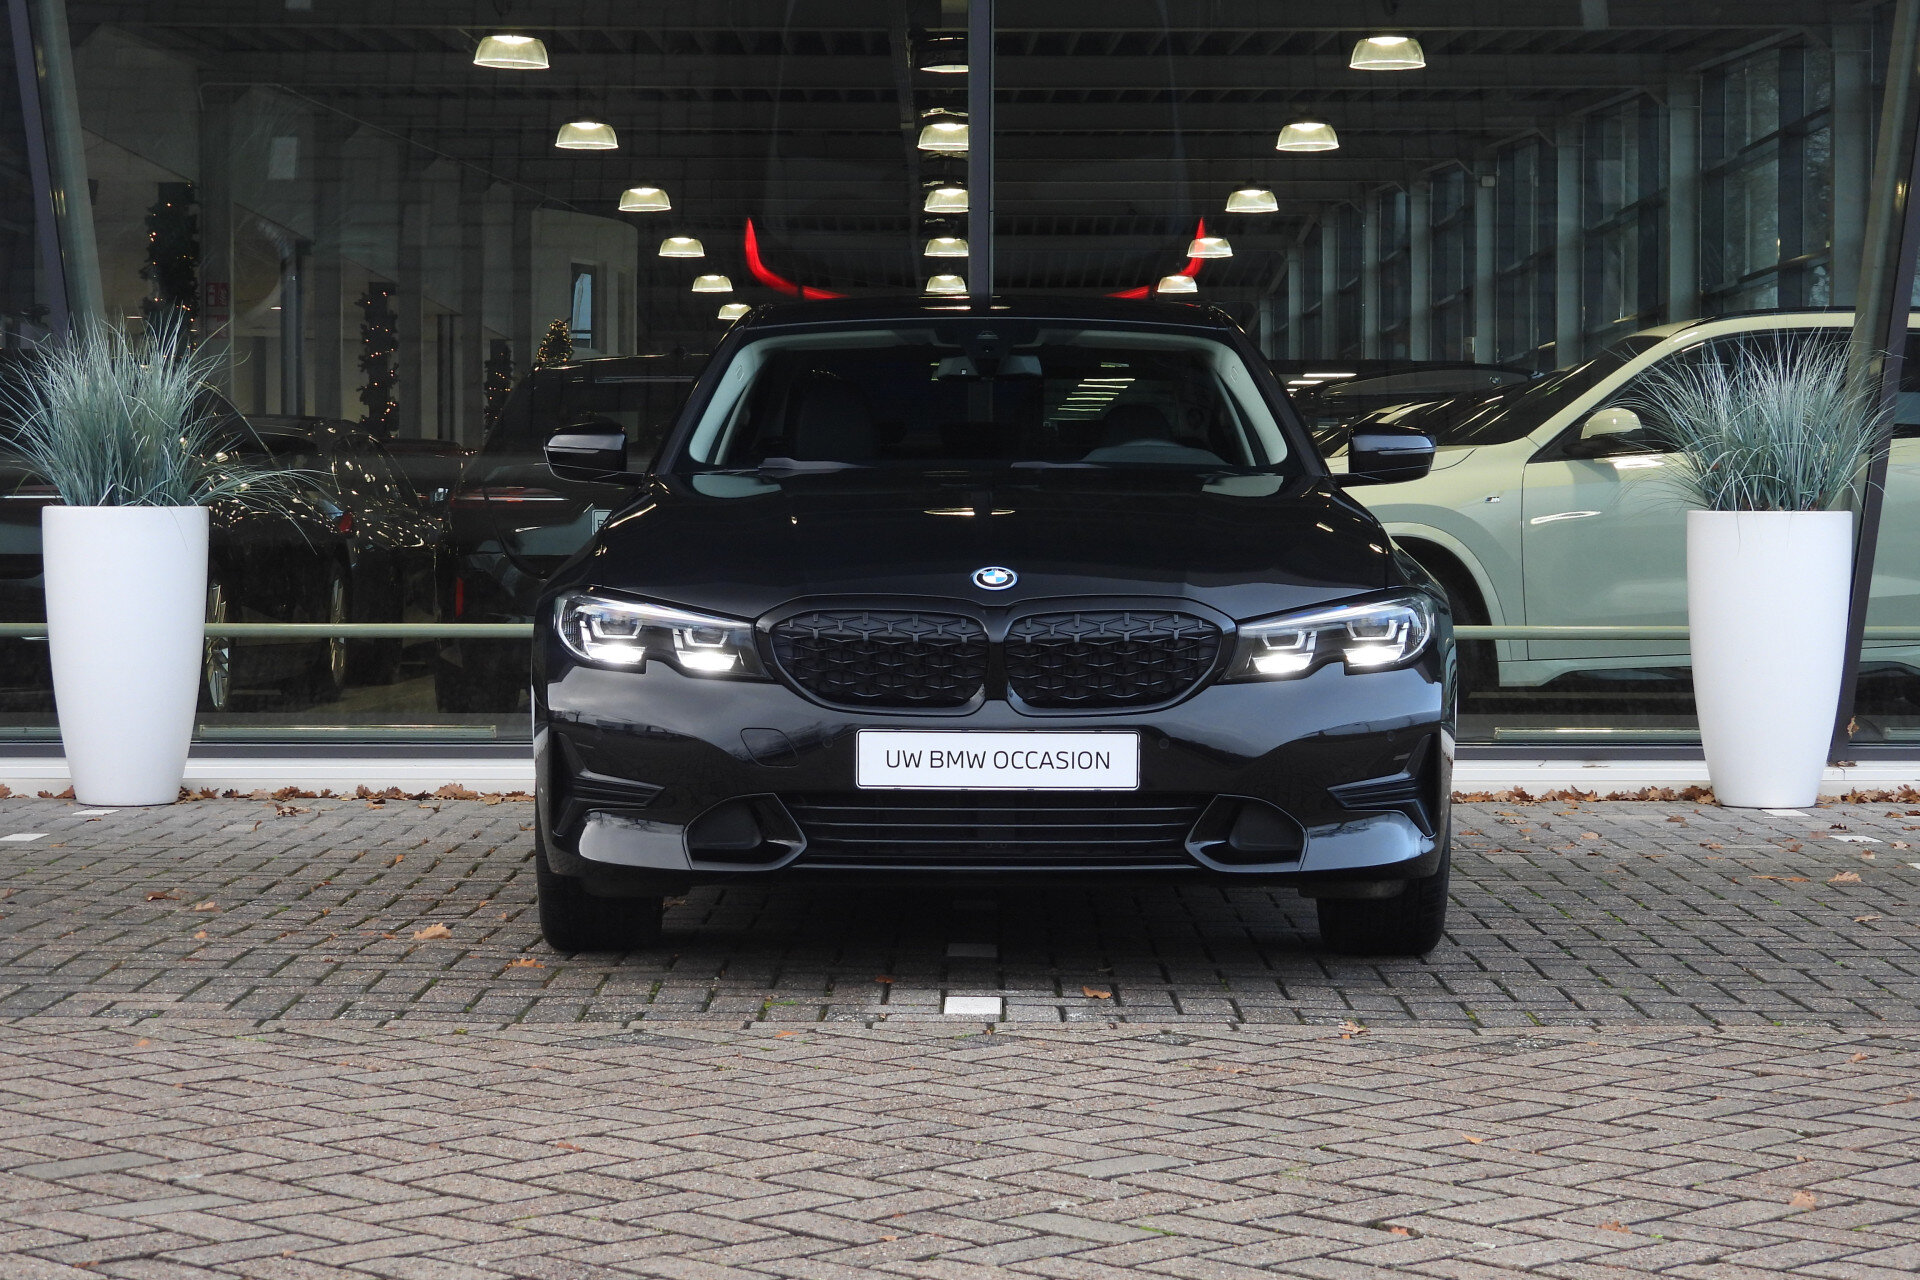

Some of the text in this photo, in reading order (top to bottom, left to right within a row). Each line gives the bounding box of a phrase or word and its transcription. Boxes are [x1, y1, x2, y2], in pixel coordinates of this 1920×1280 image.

[886, 749, 1110, 770] UW BMW OCCASION
